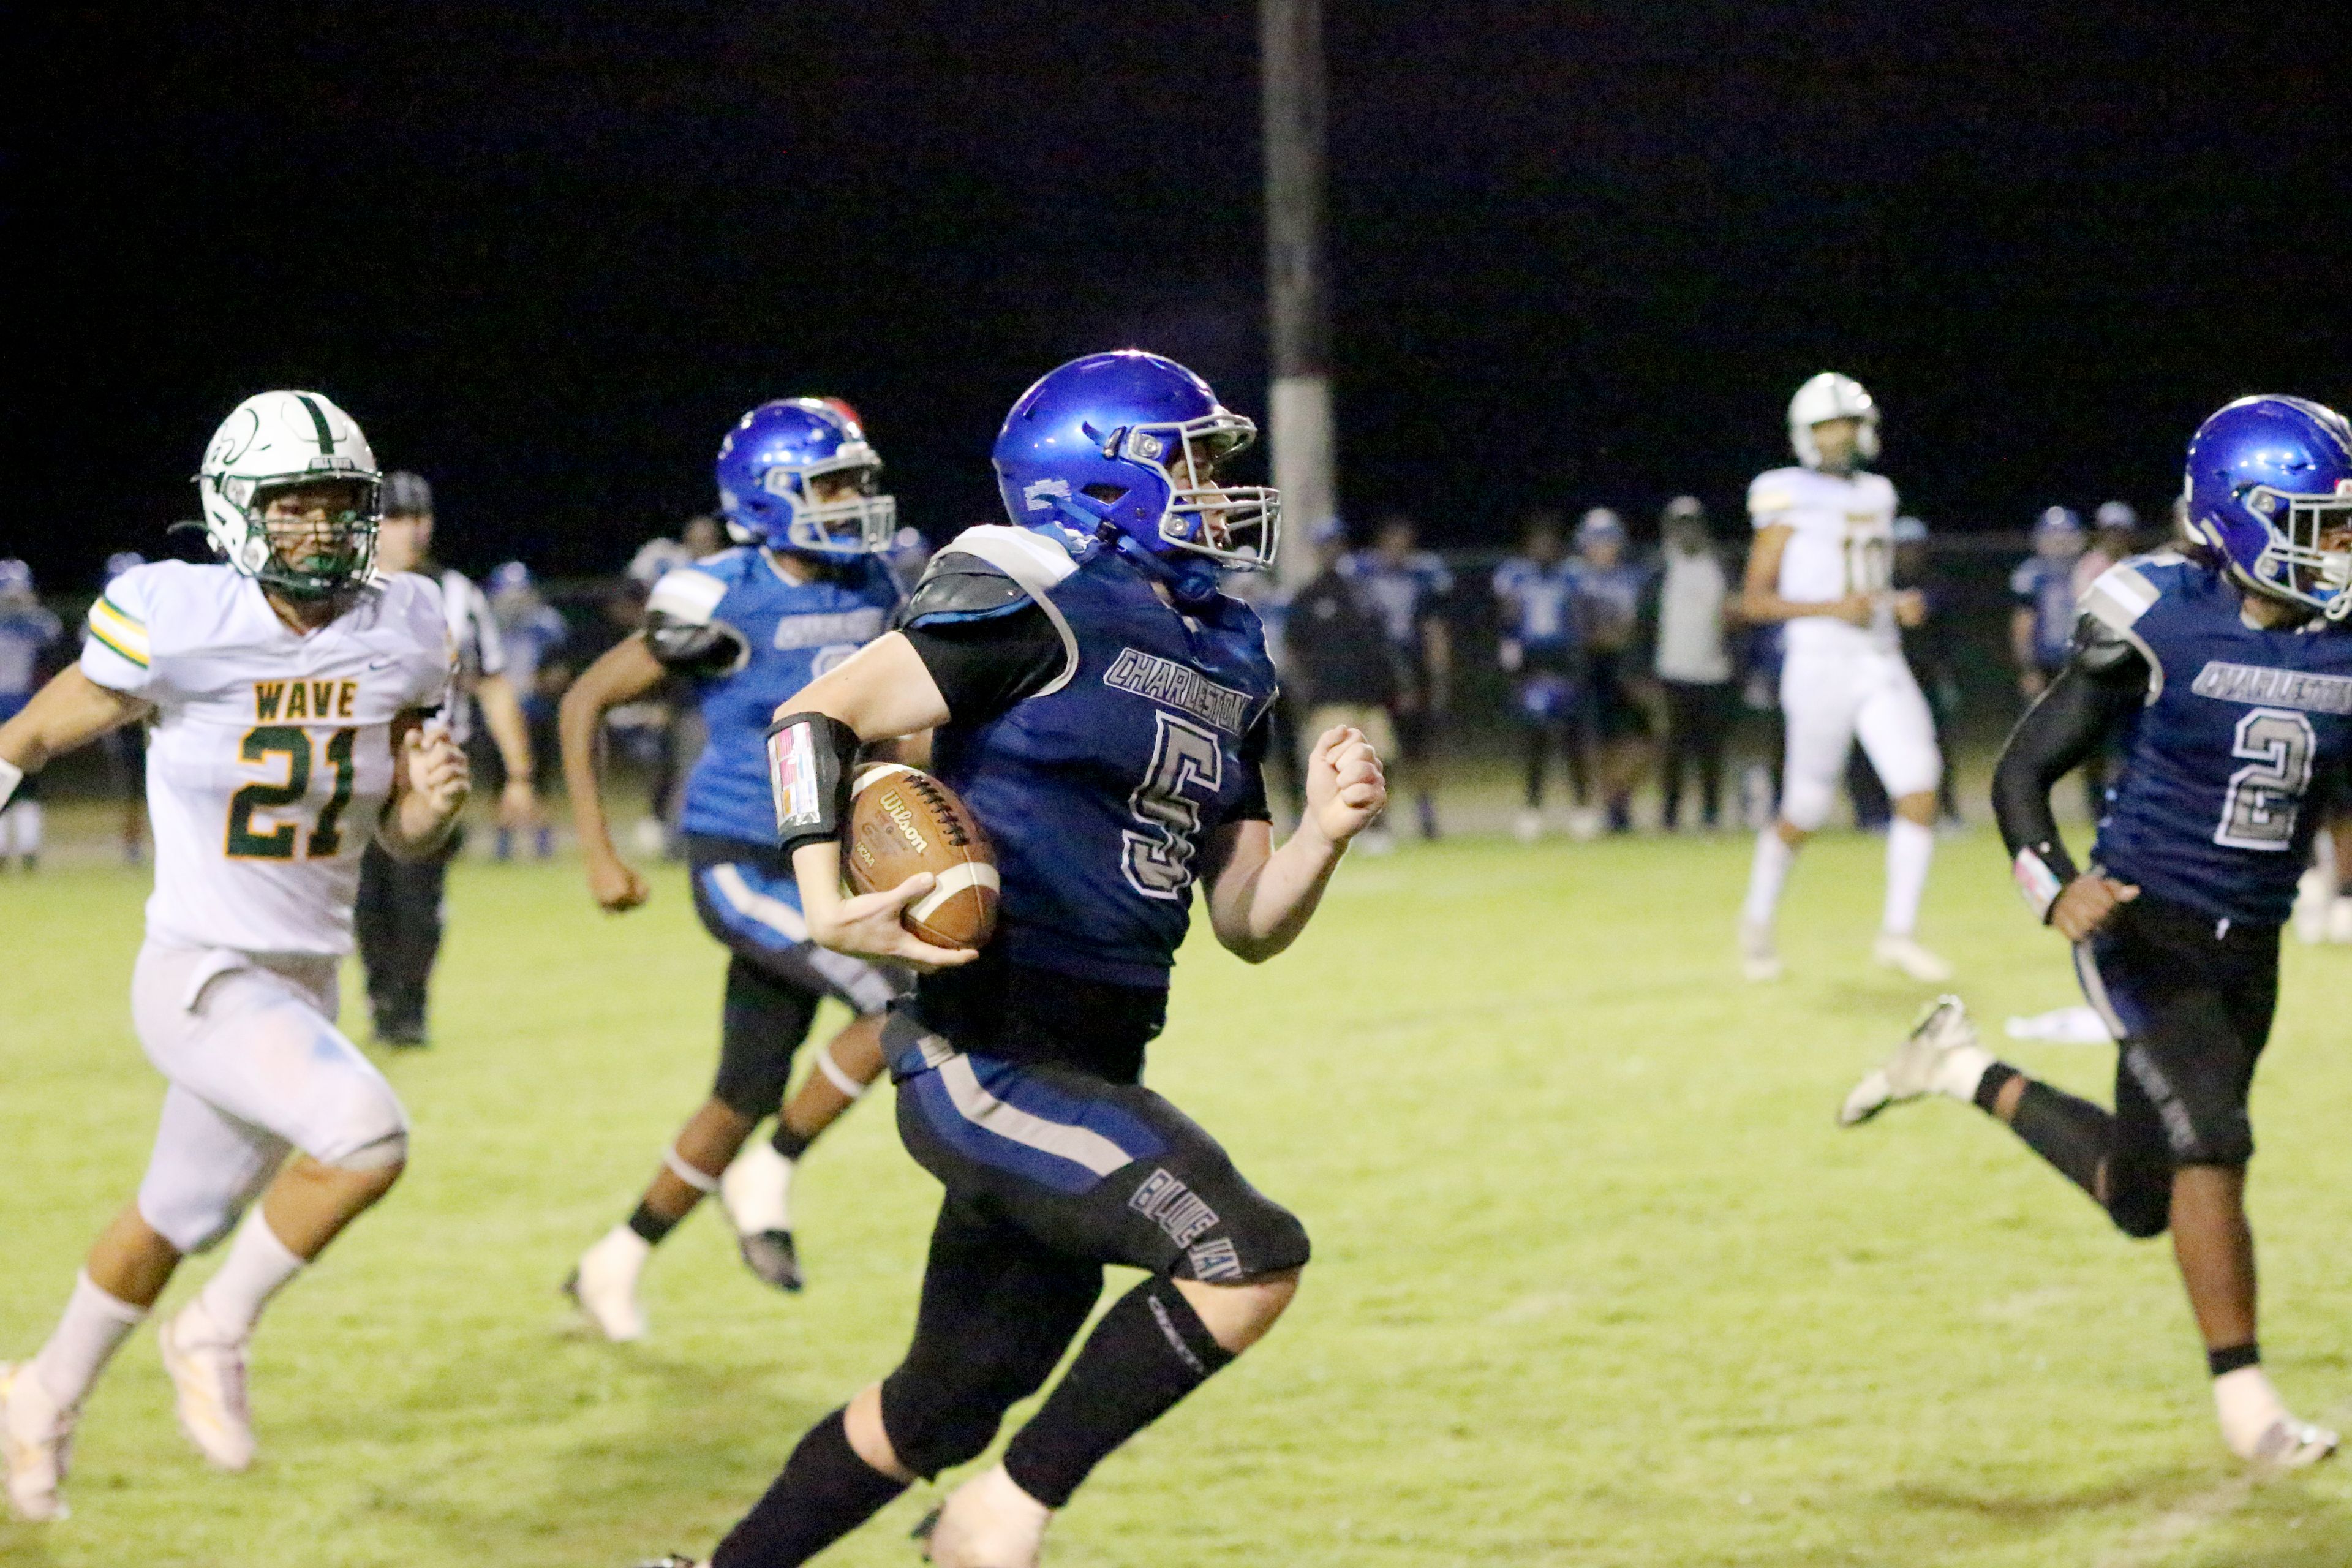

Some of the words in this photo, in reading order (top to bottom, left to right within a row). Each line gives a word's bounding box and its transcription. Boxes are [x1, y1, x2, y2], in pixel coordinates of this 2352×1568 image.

[252, 679, 359, 723] WAVE
[1103, 647, 1254, 735] CHARLESTON
[225, 725, 359, 861] 21
[879, 790, 927, 853] Wilson
[1121, 709, 1222, 900] 5
[2214, 707, 2316, 851] 2
[1128, 1167, 1220, 1250] BLUE
